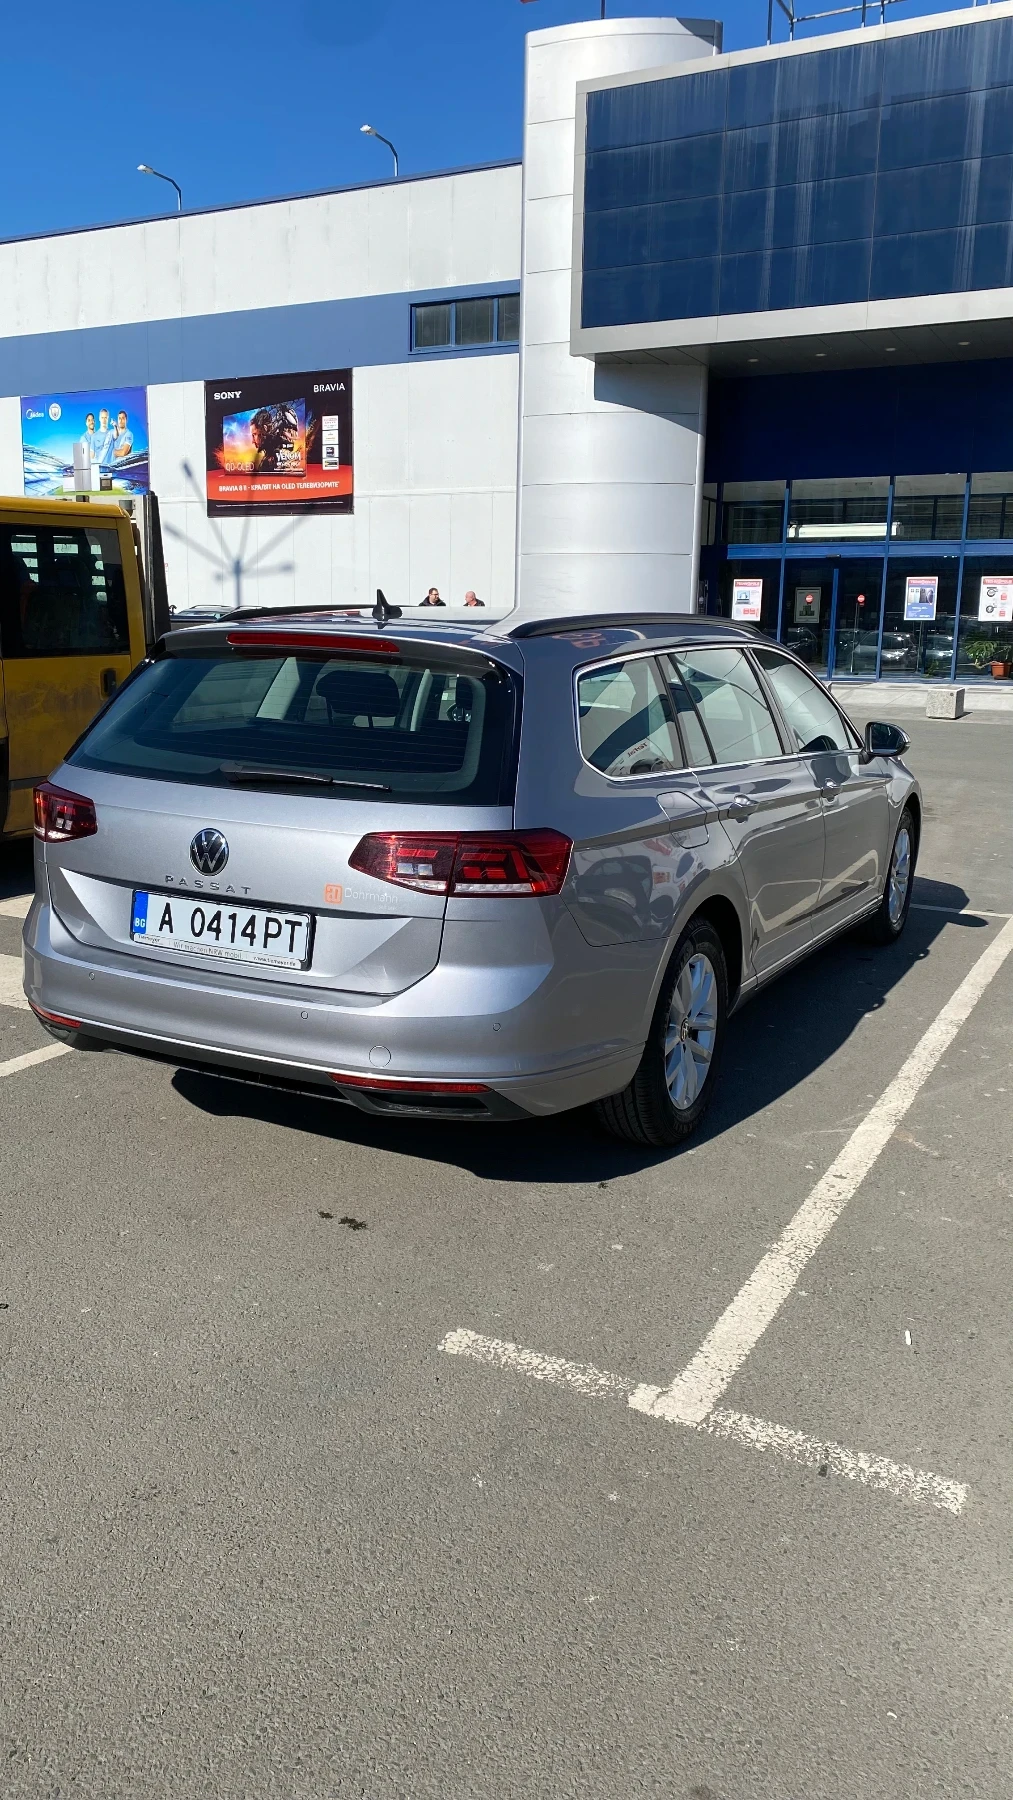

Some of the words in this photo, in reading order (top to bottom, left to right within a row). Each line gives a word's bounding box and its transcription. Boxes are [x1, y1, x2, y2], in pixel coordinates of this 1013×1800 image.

[313, 383, 345, 393] BRAVIA
[213, 391, 242, 400] SONY
[164, 875, 252, 895] PASSAT
[344, 887, 398, 904] Dohrmann
[134, 917, 146, 928] BG
[158, 902, 174, 934] A
